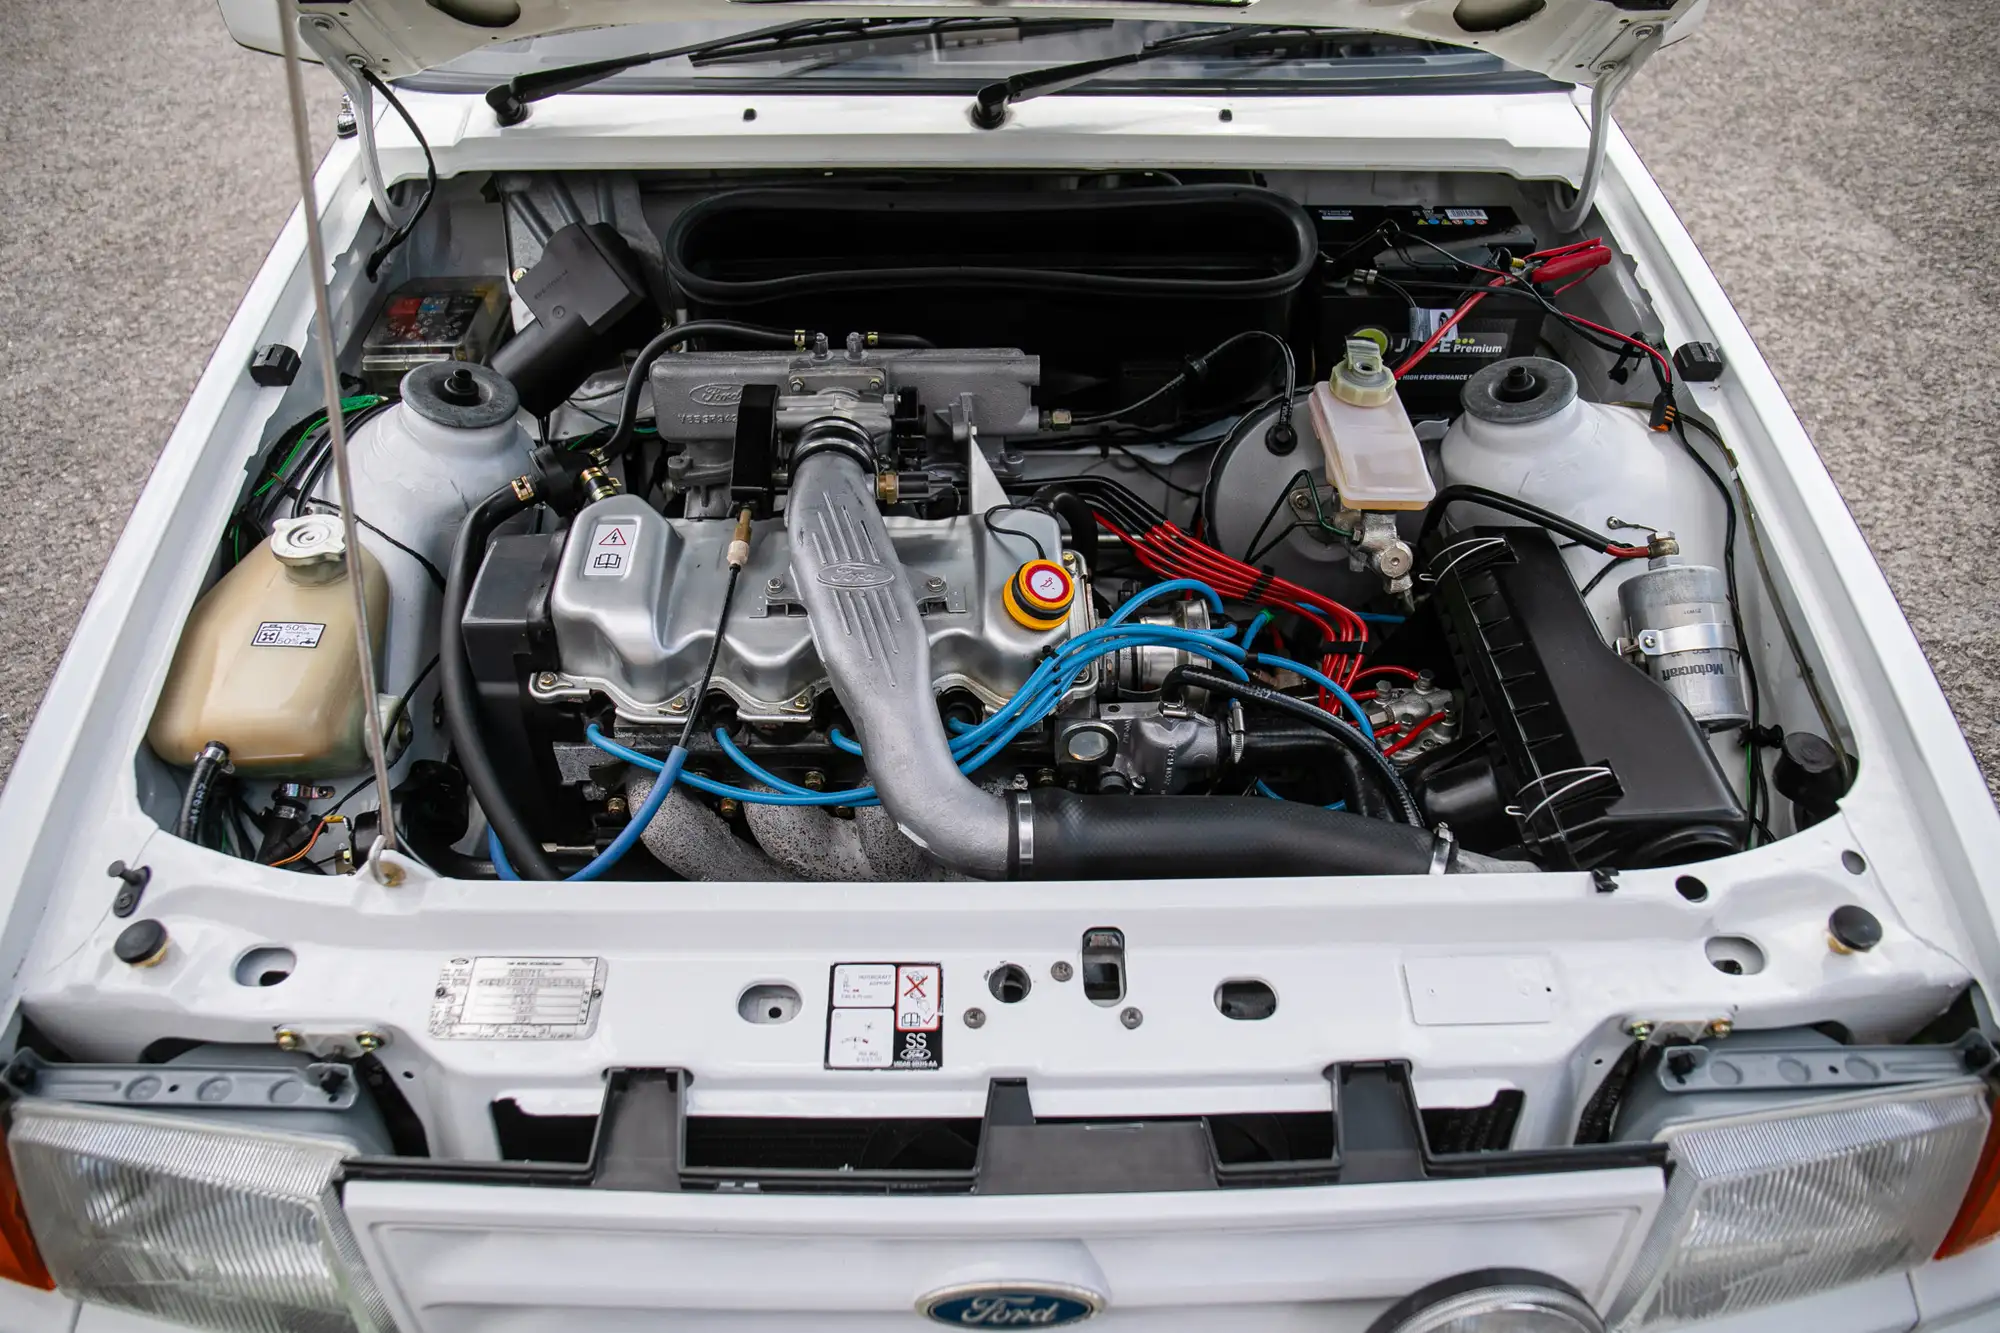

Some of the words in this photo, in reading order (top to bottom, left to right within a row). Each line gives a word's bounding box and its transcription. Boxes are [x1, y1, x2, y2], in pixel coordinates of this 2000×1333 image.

[1453, 343, 1503, 354] Premium
[702, 386, 742, 402] Ford
[831, 565, 877, 582] Ford
[1661, 663, 1725, 682] Motorcraft
[905, 1032, 927, 1050] SS
[961, 1295, 1060, 1324] Ford
